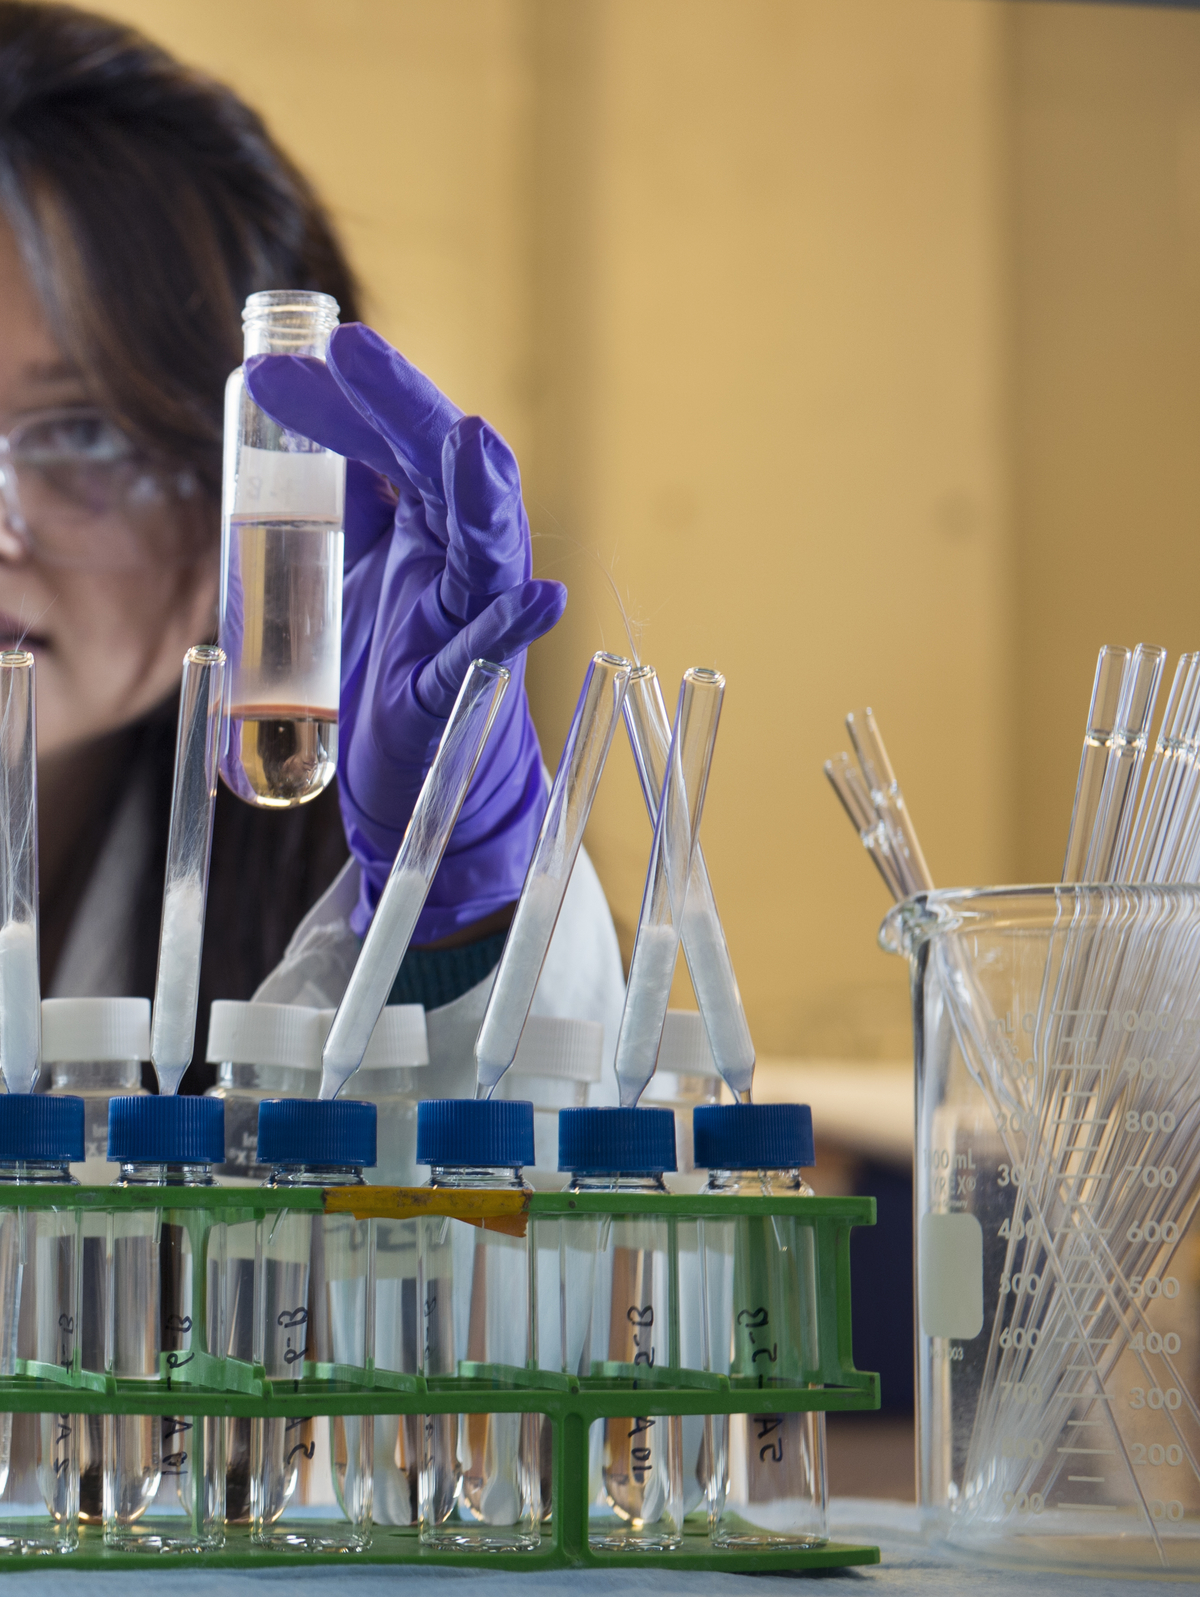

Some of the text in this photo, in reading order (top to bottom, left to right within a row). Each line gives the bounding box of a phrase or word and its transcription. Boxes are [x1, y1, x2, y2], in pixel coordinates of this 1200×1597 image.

[1110, 1010, 1176, 1033] 1000
[999, 1057, 1039, 1080] 100
[1122, 1057, 1176, 1080] 900
[996, 1110, 1040, 1134] 200
[1124, 1110, 1177, 1133] 800
[954, 1147, 977, 1170] mL
[997, 1164, 1041, 1187] 300
[1125, 1166, 1178, 1189] 700
[997, 1217, 1042, 1241] 400
[1126, 1220, 1179, 1244] 600
[998, 1273, 1041, 1295] 500
[1128, 1276, 1180, 1299] 500
[999, 1327, 1042, 1350] 600
[1128, 1332, 1181, 1355] 400
[1000, 1381, 1043, 1404] 700
[1129, 1387, 1182, 1410] 300
[1001, 1436, 1044, 1460] 800
[1131, 1443, 1183, 1467] 200
[1002, 1491, 1045, 1514] 900
[1135, 1499, 1185, 1522] 100
